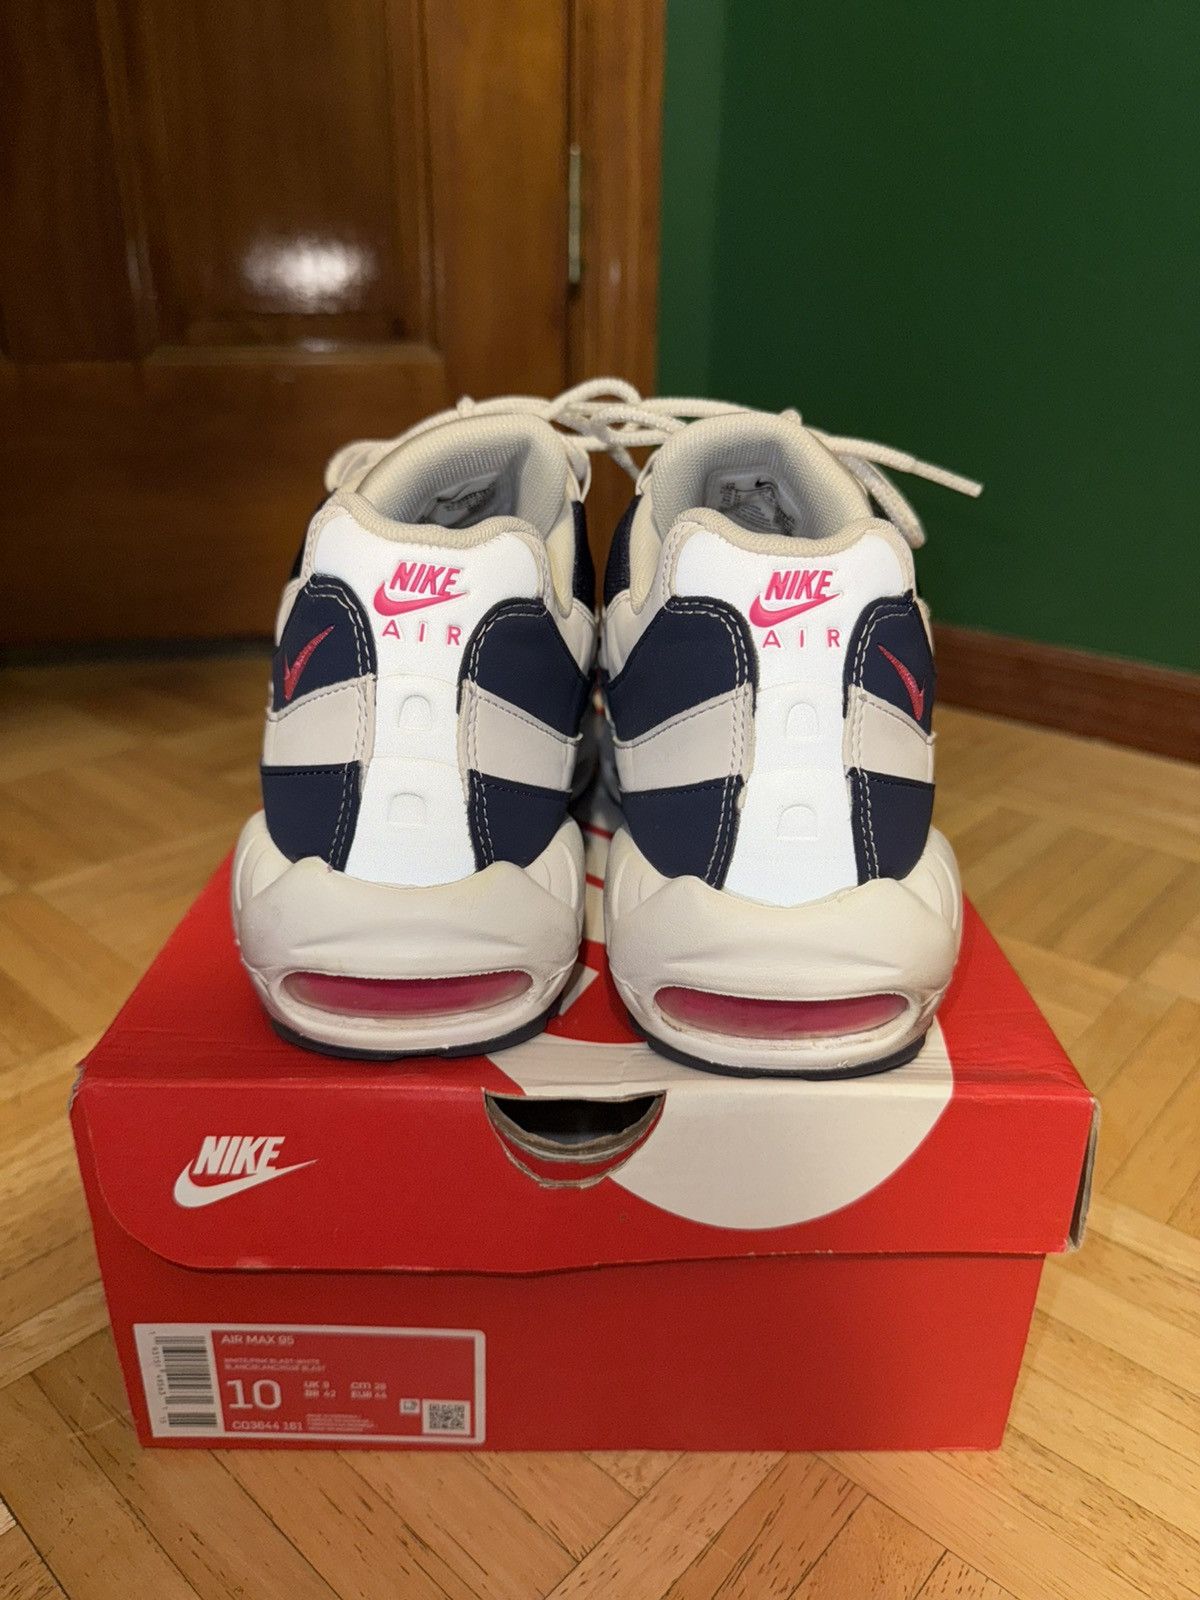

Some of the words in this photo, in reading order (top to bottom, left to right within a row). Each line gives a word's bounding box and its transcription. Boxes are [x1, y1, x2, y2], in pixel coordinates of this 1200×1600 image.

[389, 561, 461, 597] NIKE
[765, 570, 834, 600] NIKE
[382, 619, 462, 646] AIR
[762, 629, 841, 649] AIR
[192, 1135, 286, 1176] NIKE
[221, 1334, 243, 1345] AIR
[246, 1335, 276, 1346] MAX
[278, 1335, 295, 1347] 95
[226, 1379, 282, 1410] 10
